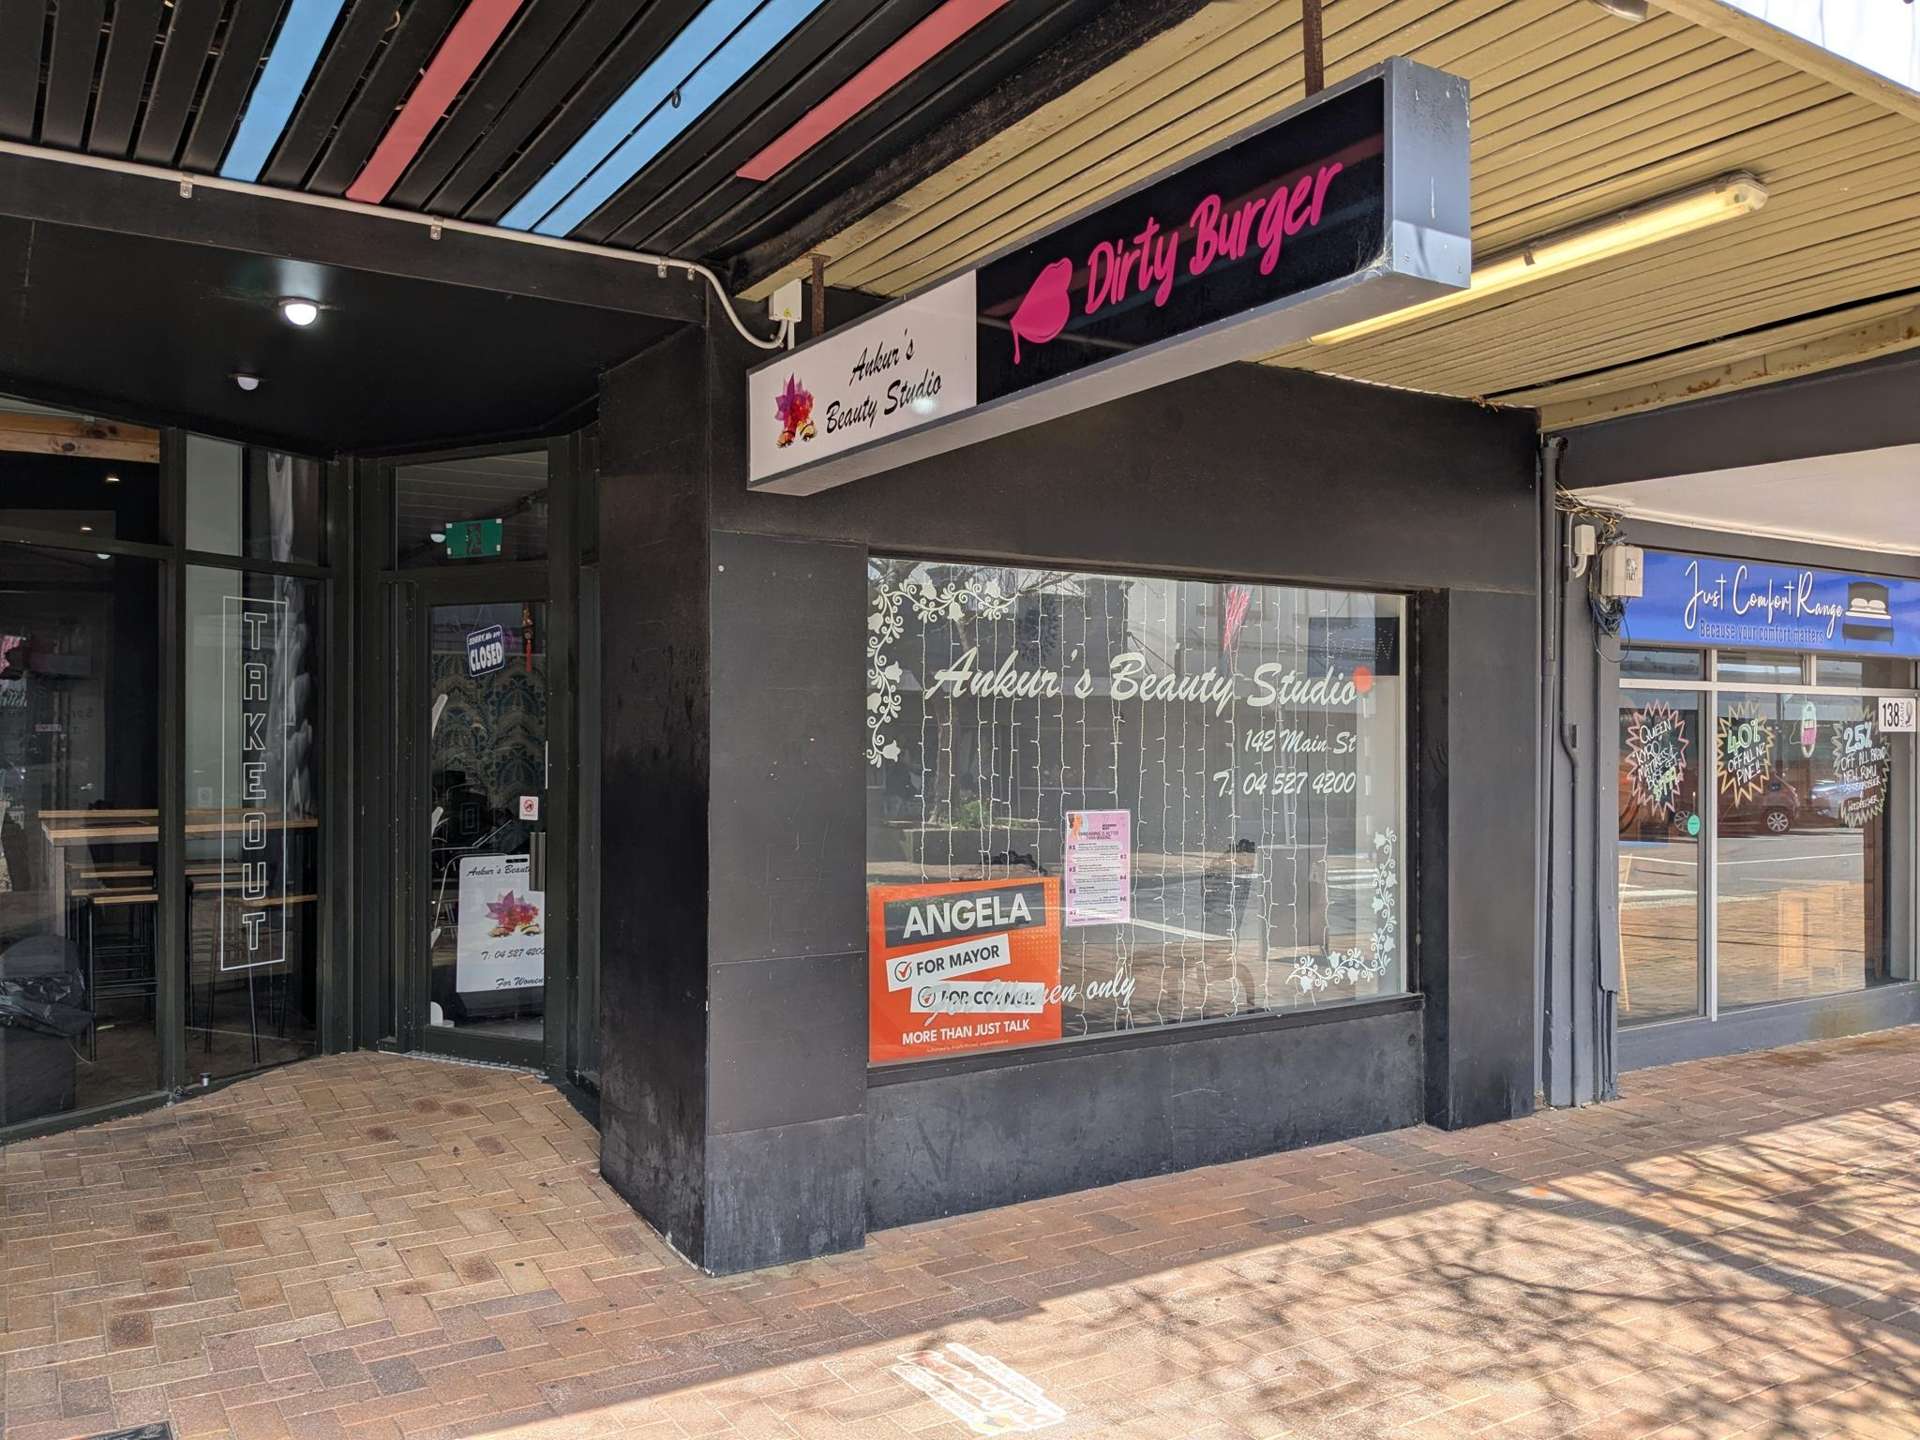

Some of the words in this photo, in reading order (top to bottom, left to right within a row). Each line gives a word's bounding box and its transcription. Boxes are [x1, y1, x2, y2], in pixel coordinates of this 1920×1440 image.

[1085, 217, 1179, 307] Dirty
[1189, 162, 1343, 276] Burger
[848, 327, 915, 387] Ankur's
[826, 394, 878, 434] Beauty
[883, 367, 942, 416] Studio
[1684, 560, 1727, 630] Just
[1733, 565, 1795, 625] Comfort
[1796, 571, 1844, 640] Range
[1700, 620, 1736, 641] Because
[1738, 624, 1757, 643] your
[1759, 625, 1792, 642] comfort
[1793, 627, 1824, 645] matters
[470, 642, 503, 671] CLOSED
[925, 646, 1094, 700] Ankur's
[1110, 652, 1235, 717] Beauty
[1247, 662, 1357, 707] Studio
[1882, 702, 1900, 727] 138
[1244, 729, 1275, 753] 142
[1279, 728, 1328, 753] Main
[1333, 731, 1358, 754] St
[1640, 719, 1672, 744] QUEEN
[1728, 718, 1760, 756] 40%
[1843, 721, 1873, 754] 25%
[1728, 753, 1742, 773] OFF
[1743, 748, 1757, 764] ALL
[1840, 752, 1856, 771] OFF
[1858, 750, 1870, 767] ALL
[241, 611, 268, 951] TAKEOUT
[1242, 772, 1269, 796] 04
[1271, 771, 1309, 796] 527
[1311, 771, 1357, 796] 4200
[466, 866, 501, 877] Ankur's
[504, 864, 531, 874] Beaut
[903, 893, 1032, 939] ANGELA
[494, 950, 506, 959] 04
[507, 948, 525, 959] 527
[916, 956, 945, 976] FOR
[950, 944, 1000, 968] MAYOR
[496, 978, 511, 990] For
[1086, 967, 1136, 1006] only
[902, 1032, 938, 1046] MORE
[940, 1026, 973, 1040] THAN
[974, 1022, 1001, 1037] JUST
[1003, 1019, 1030, 1033] TALK
